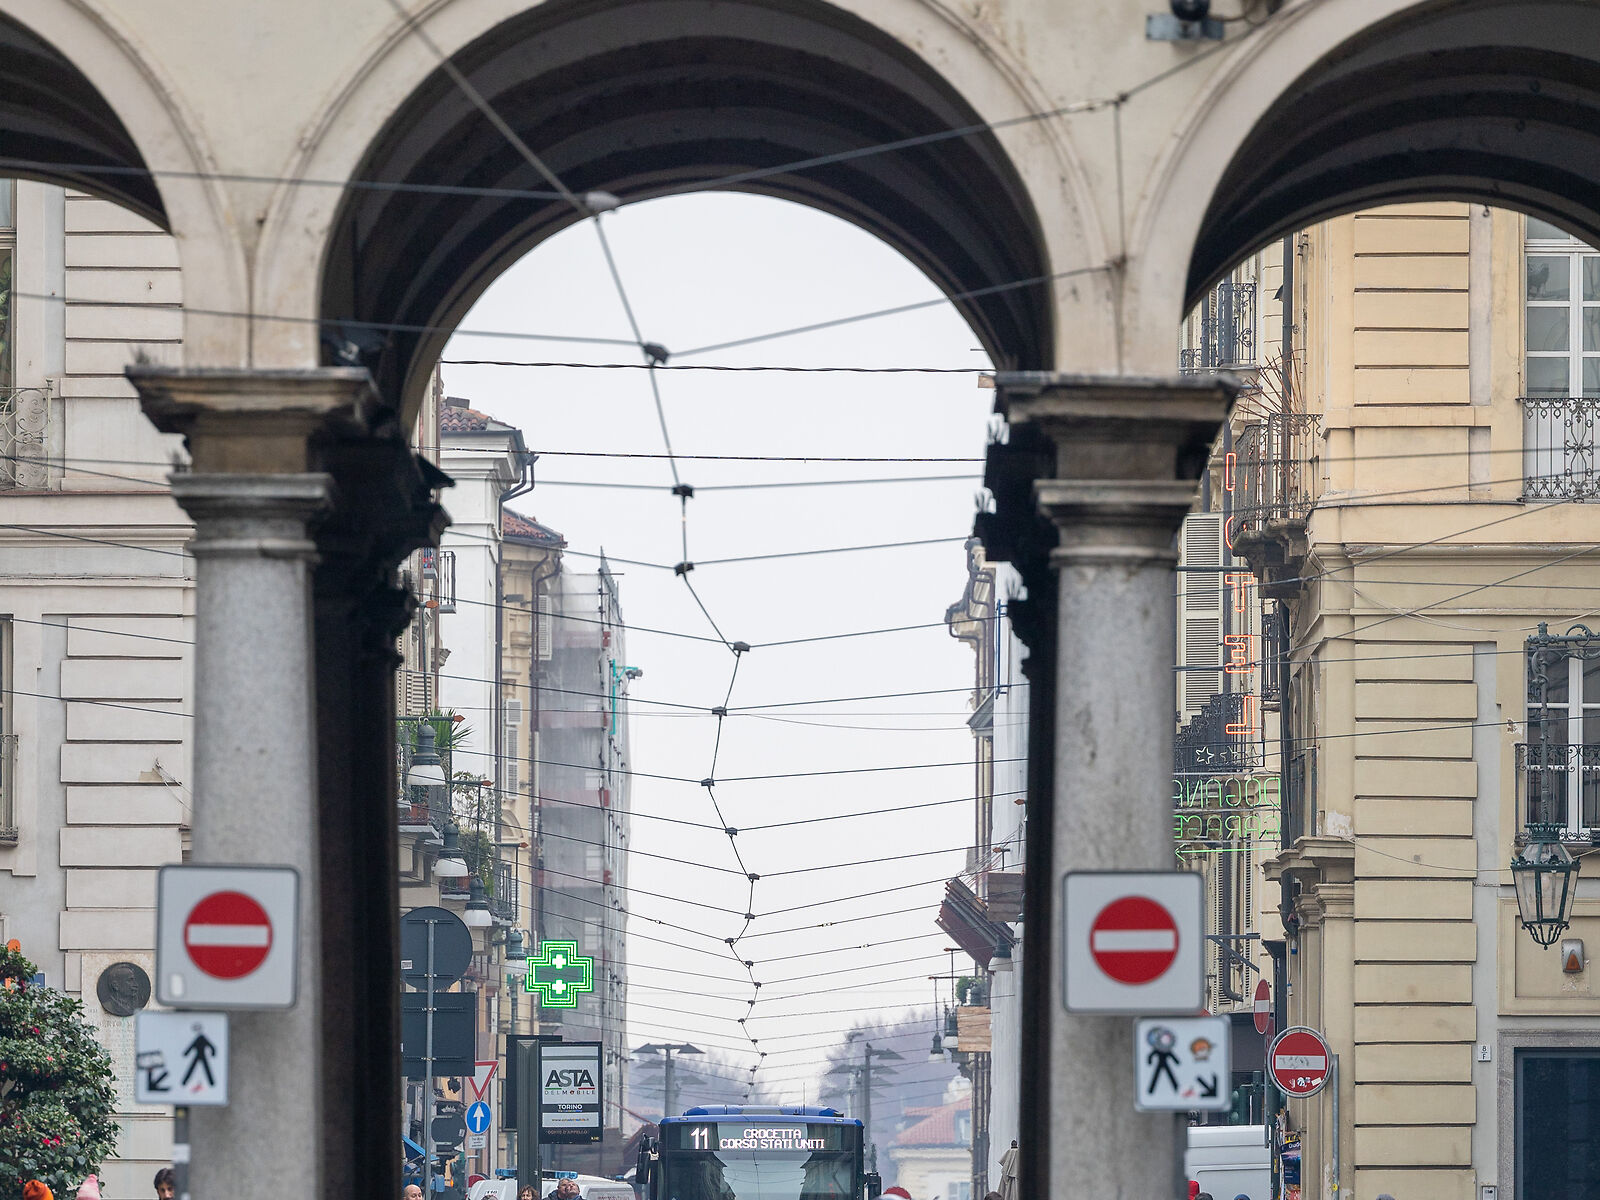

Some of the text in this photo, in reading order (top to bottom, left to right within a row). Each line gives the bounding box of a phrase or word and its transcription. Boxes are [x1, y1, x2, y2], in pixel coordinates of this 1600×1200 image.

[545, 1069, 595, 1087] ASTA
[690, 1127, 708, 1149] 11
[743, 1128, 801, 1139] CROCETTA
[720, 1138, 825, 1149] CORSO STATI UNITI
